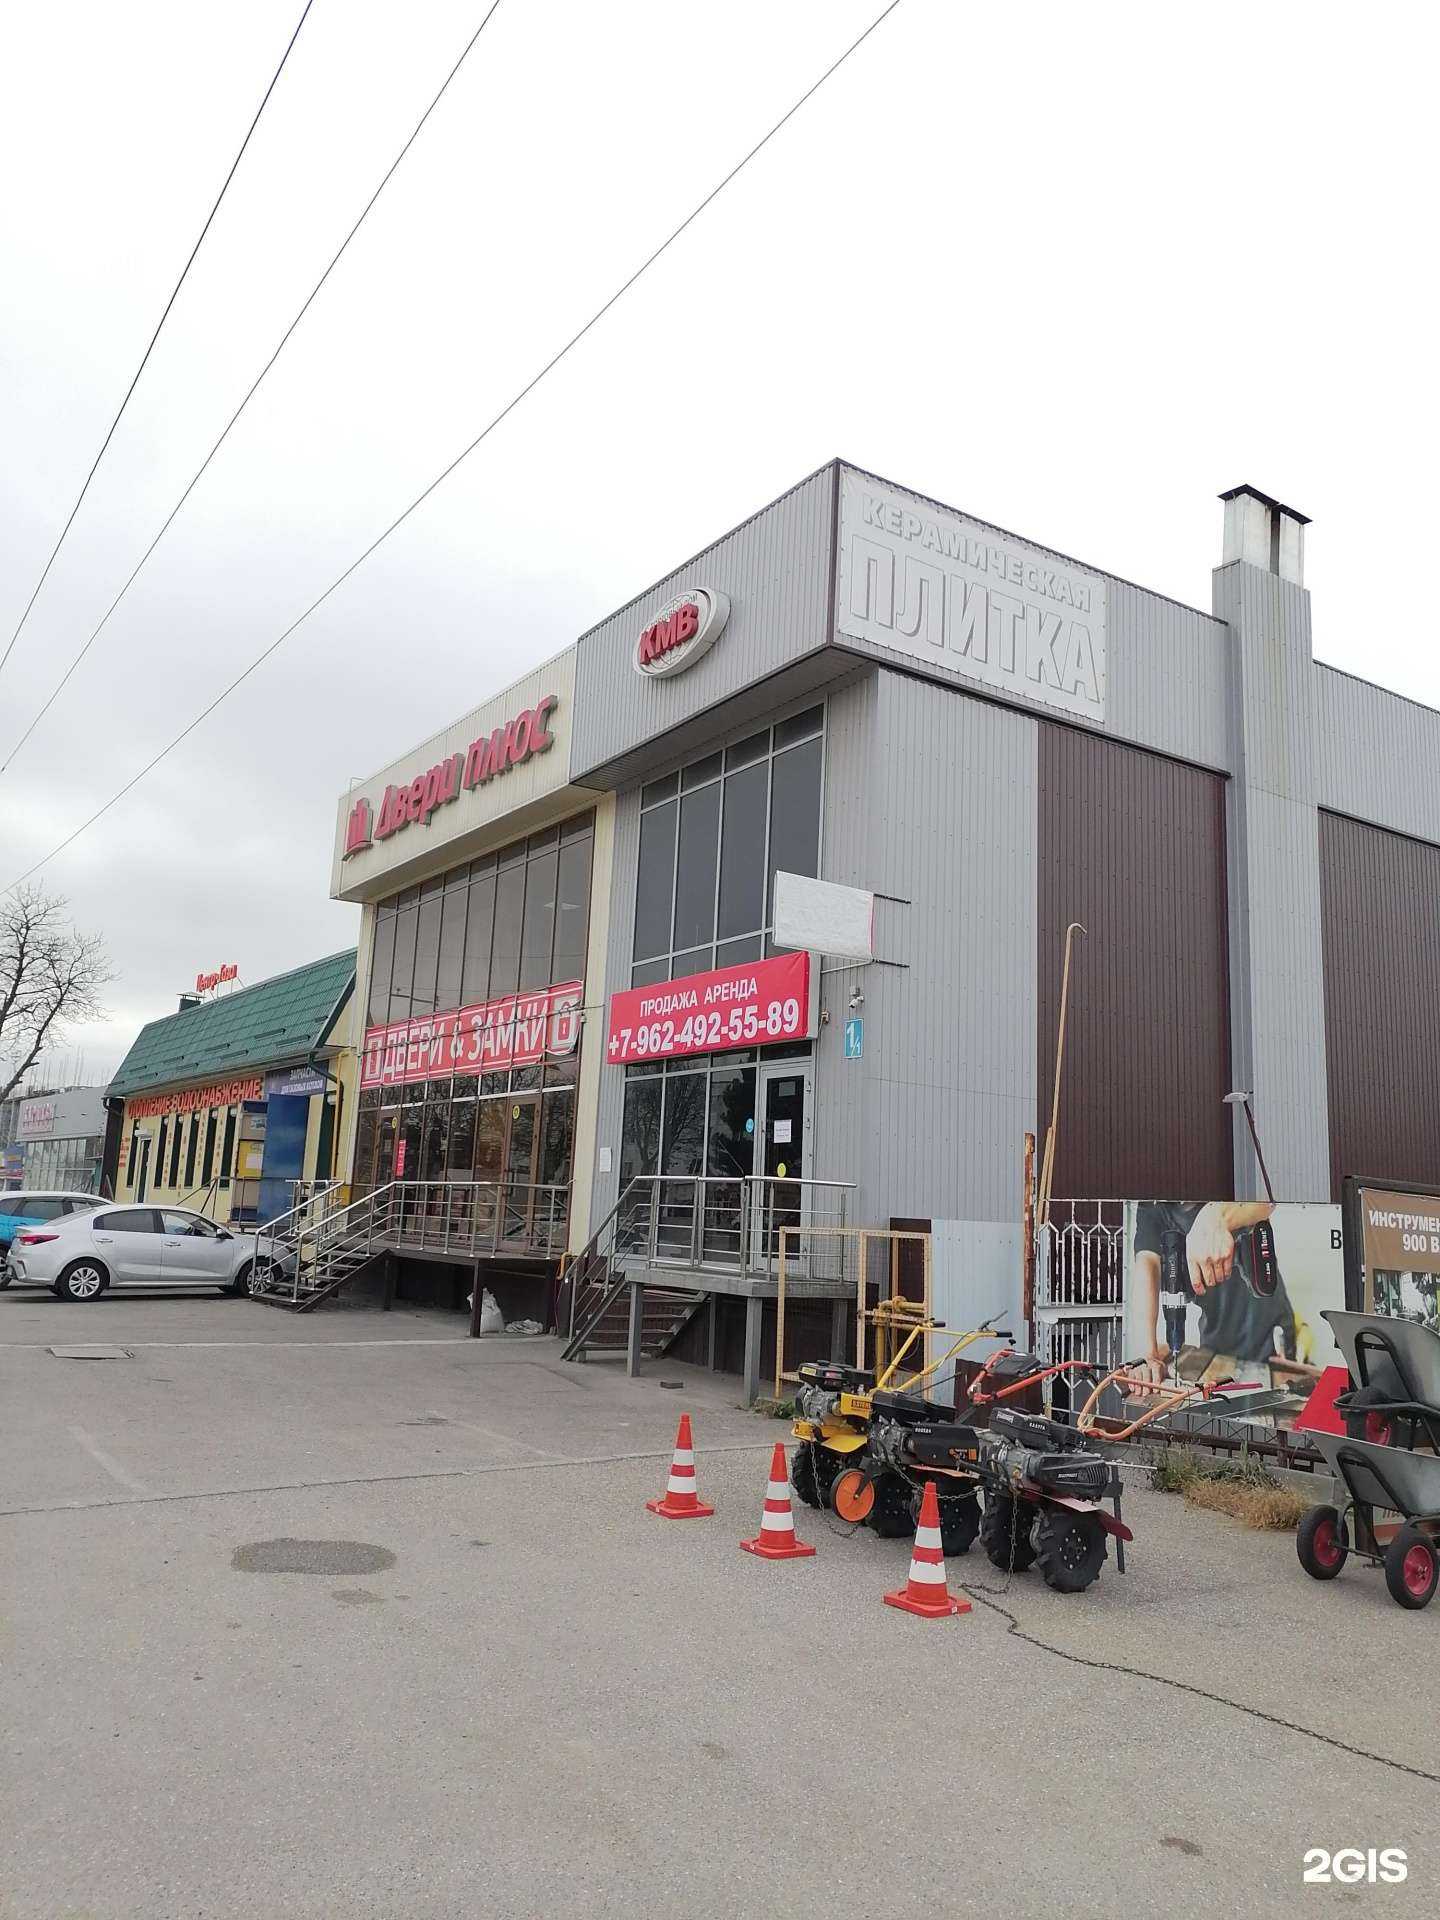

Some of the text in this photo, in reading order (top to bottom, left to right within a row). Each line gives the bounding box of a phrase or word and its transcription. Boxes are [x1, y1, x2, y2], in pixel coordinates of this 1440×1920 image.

[863, 493, 1091, 612] КЕРАМИЧЕСКАЯ
[850, 534, 1100, 704] ПЛИТКА
[609, 998, 799, 1057] +7-962-492-55-89
[640, 977, 758, 1017] ПРОДАЖА АРЕНДА
[384, 1021, 446, 1081] ДВЕРИ
[468, 999, 548, 1061] ЗАМКИ
[1403, 1234, 1427, 1252] 900
